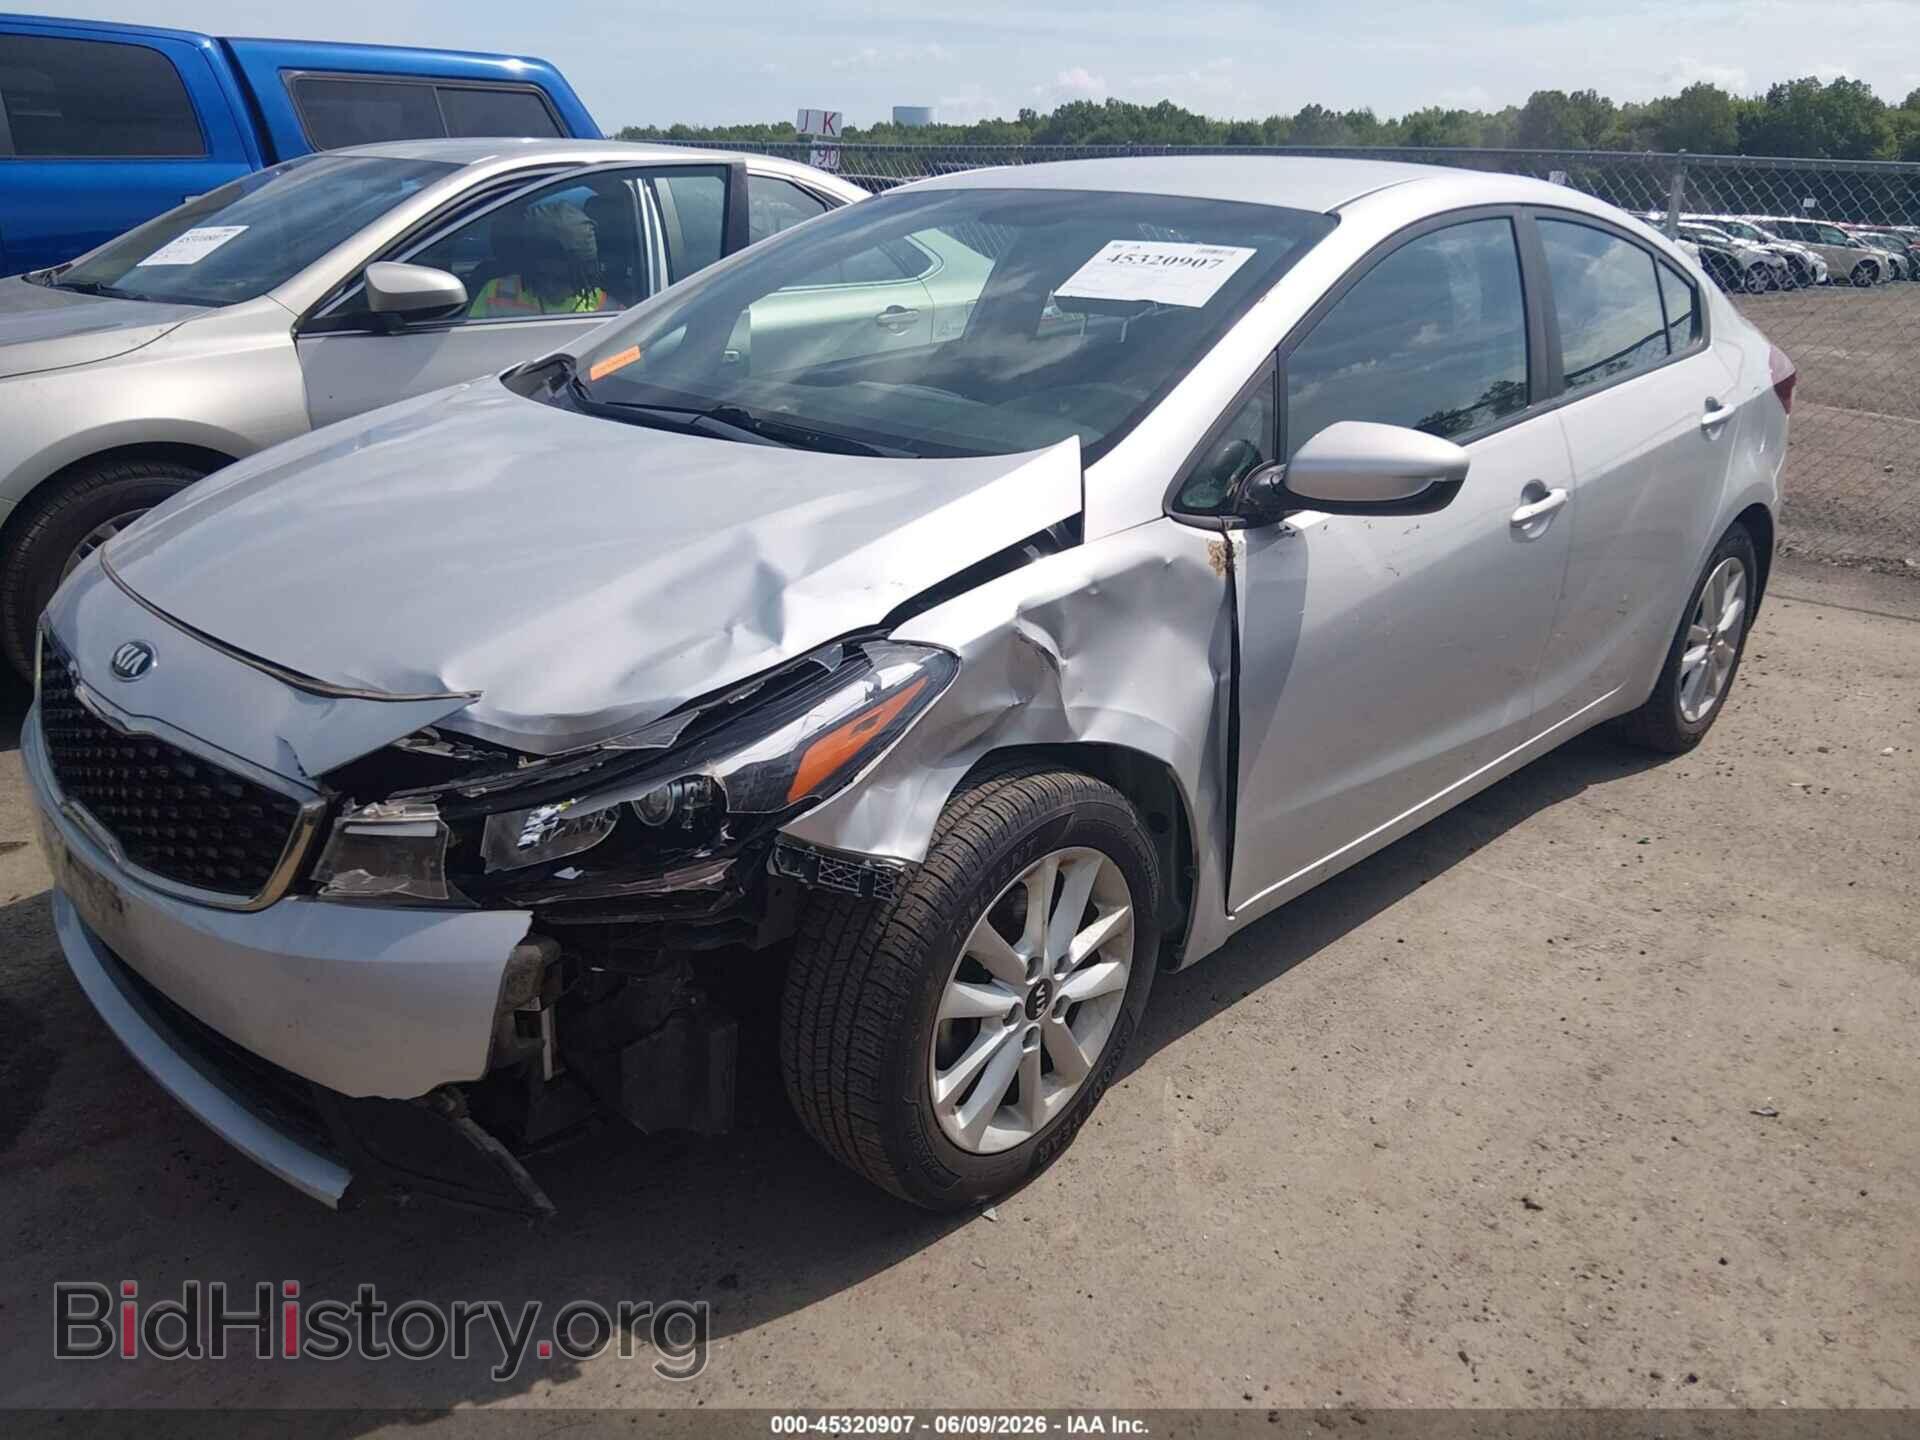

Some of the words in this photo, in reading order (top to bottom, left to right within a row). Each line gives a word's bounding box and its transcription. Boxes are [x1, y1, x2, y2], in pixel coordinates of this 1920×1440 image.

[800, 109, 810, 133] J
[822, 111, 838, 136] K
[1107, 253, 1224, 269] 45320907
[1035, 983, 1047, 1018] KIA
